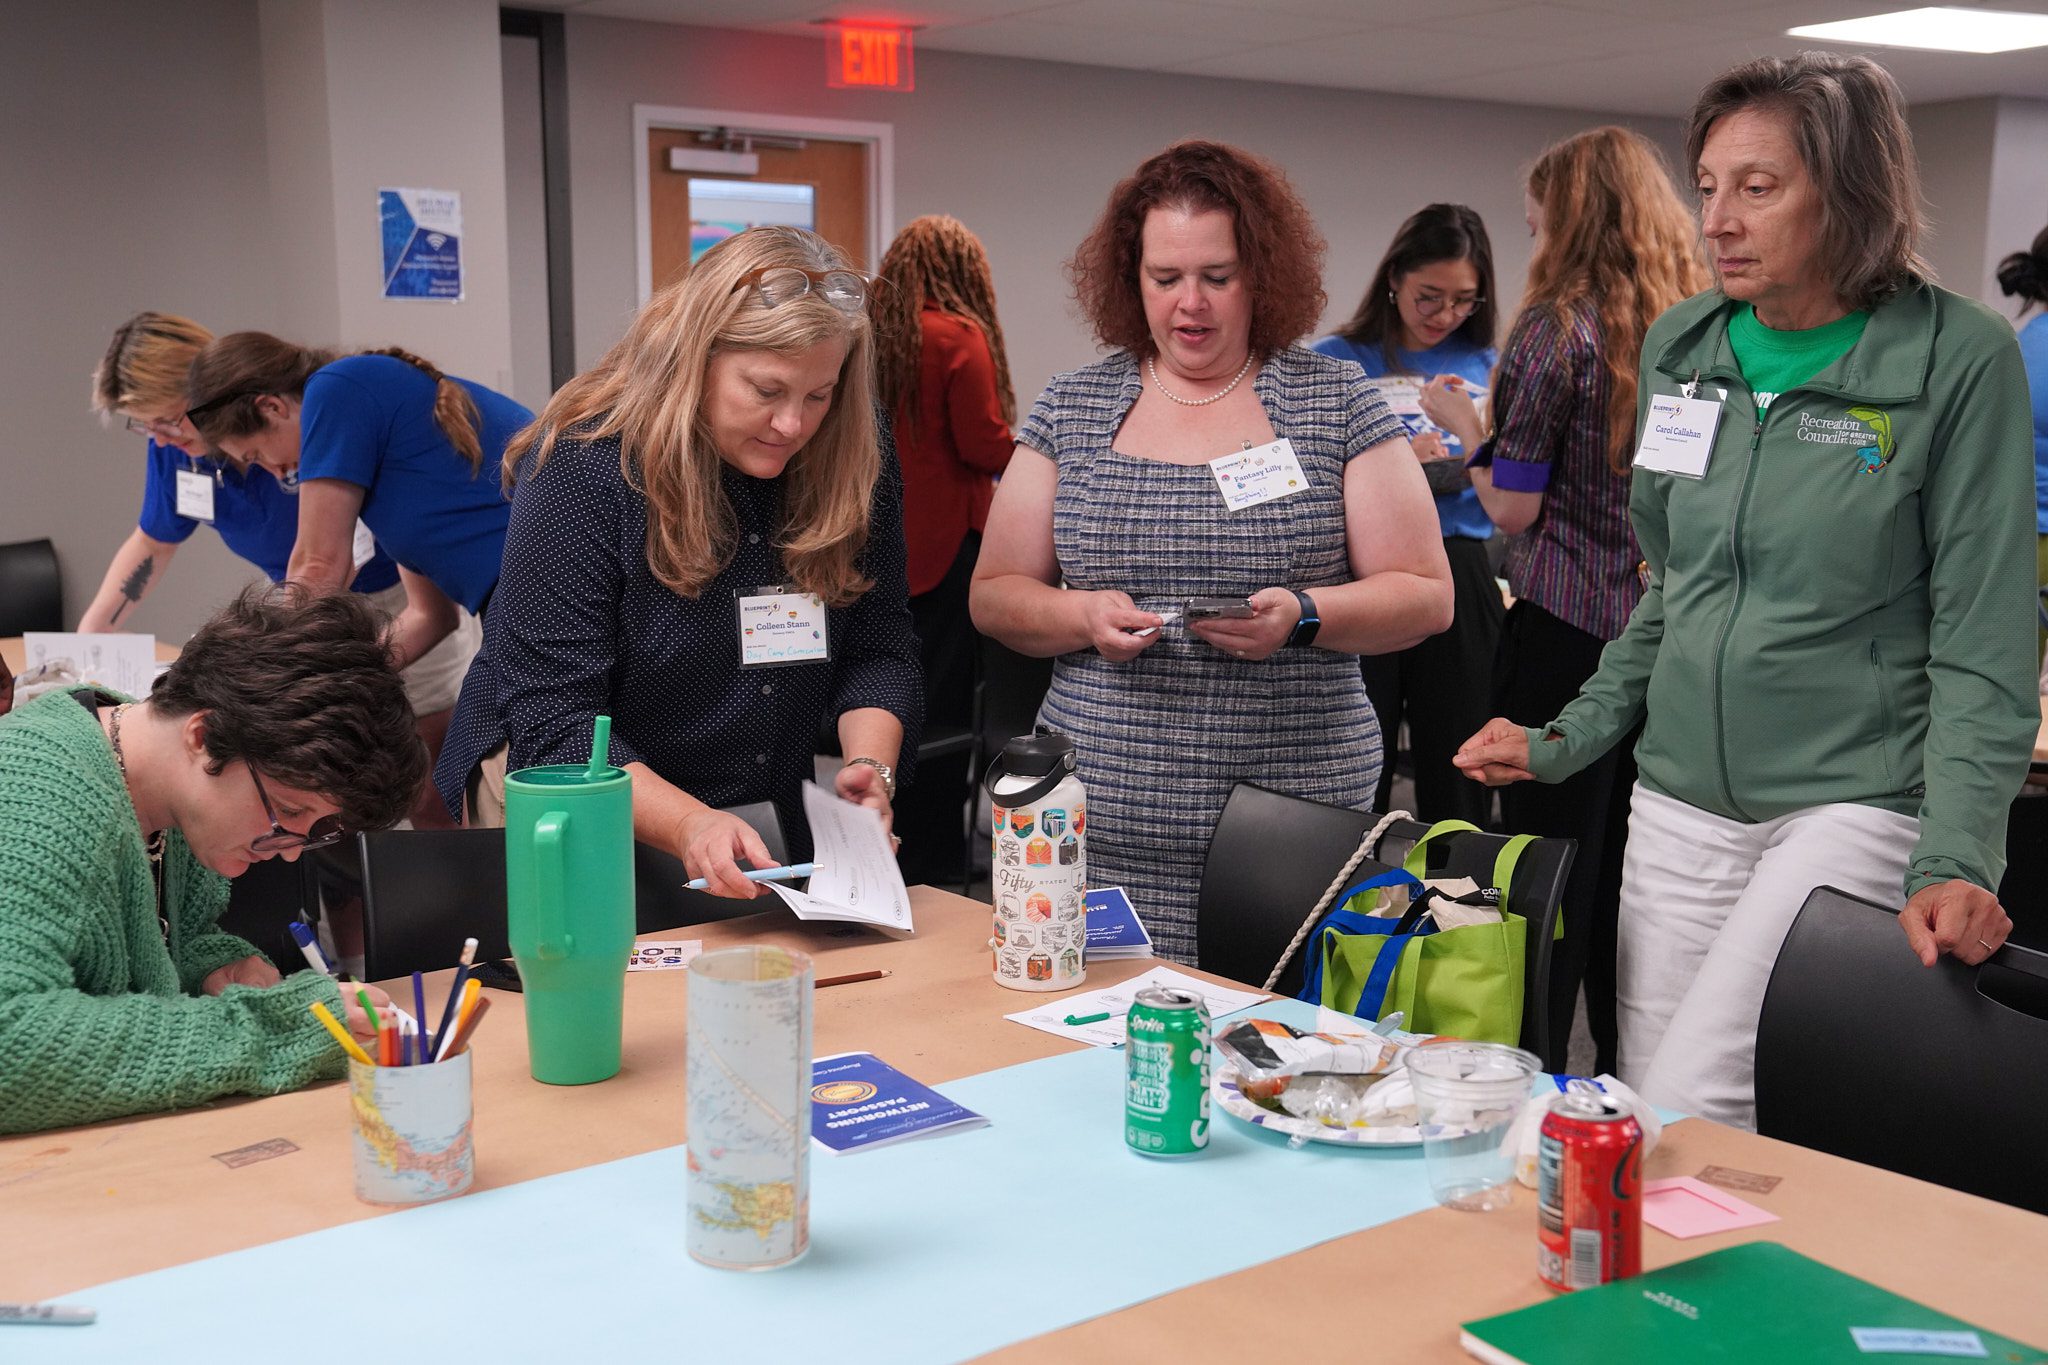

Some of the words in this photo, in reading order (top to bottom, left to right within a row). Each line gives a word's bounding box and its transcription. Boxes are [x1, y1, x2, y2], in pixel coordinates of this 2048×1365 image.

[842, 31, 899, 85] EXIT
[1653, 404, 1675, 412] BLUEPRINT
[1799, 412, 1860, 431] Recreation
[1655, 425, 1673, 433] Carol
[1673, 427, 1702, 439] Callahan
[1797, 427, 1842, 444] Council
[1850, 431, 1877, 441] GREATER
[1849, 438, 1866, 446] LOUIS
[1234, 470, 1264, 483] Fantasy
[1264, 464, 1282, 474] Lilly
[756, 622, 785, 631] Colleen
[786, 621, 810, 629] Stann
[999, 868, 1036, 894] Fifty
[1131, 1014, 1165, 1033] Sprite
[825, 1101, 930, 1129] NETWORKING
[828, 1097, 908, 1119] PASSPORT
